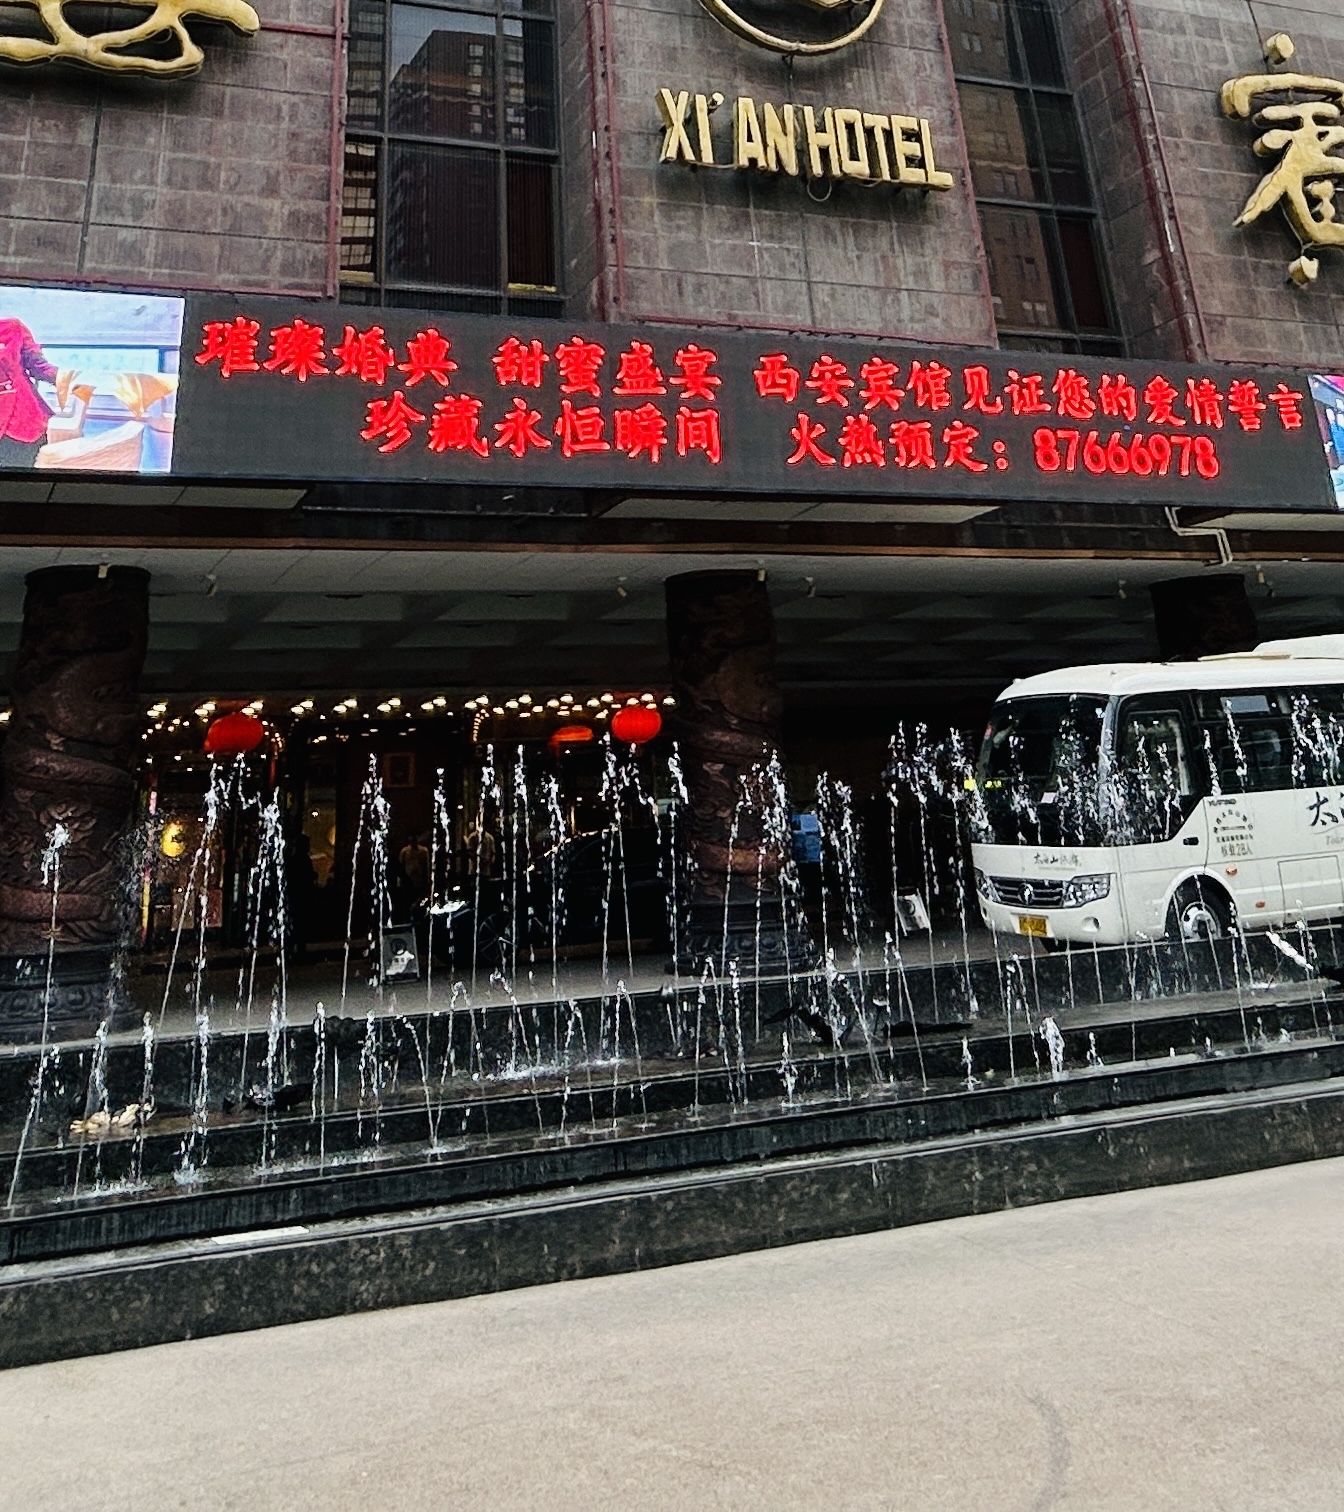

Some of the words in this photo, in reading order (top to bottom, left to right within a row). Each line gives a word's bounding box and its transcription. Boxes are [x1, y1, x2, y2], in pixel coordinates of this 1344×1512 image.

[194, 316, 457, 389] 璀璨婚典
[493, 336, 721, 403] 甜蜜盛宴
[753, 352, 1303, 432] 西安宾馆见证您的爱情誓言
[360, 390, 723, 464] 珍藏永恒瞬间
